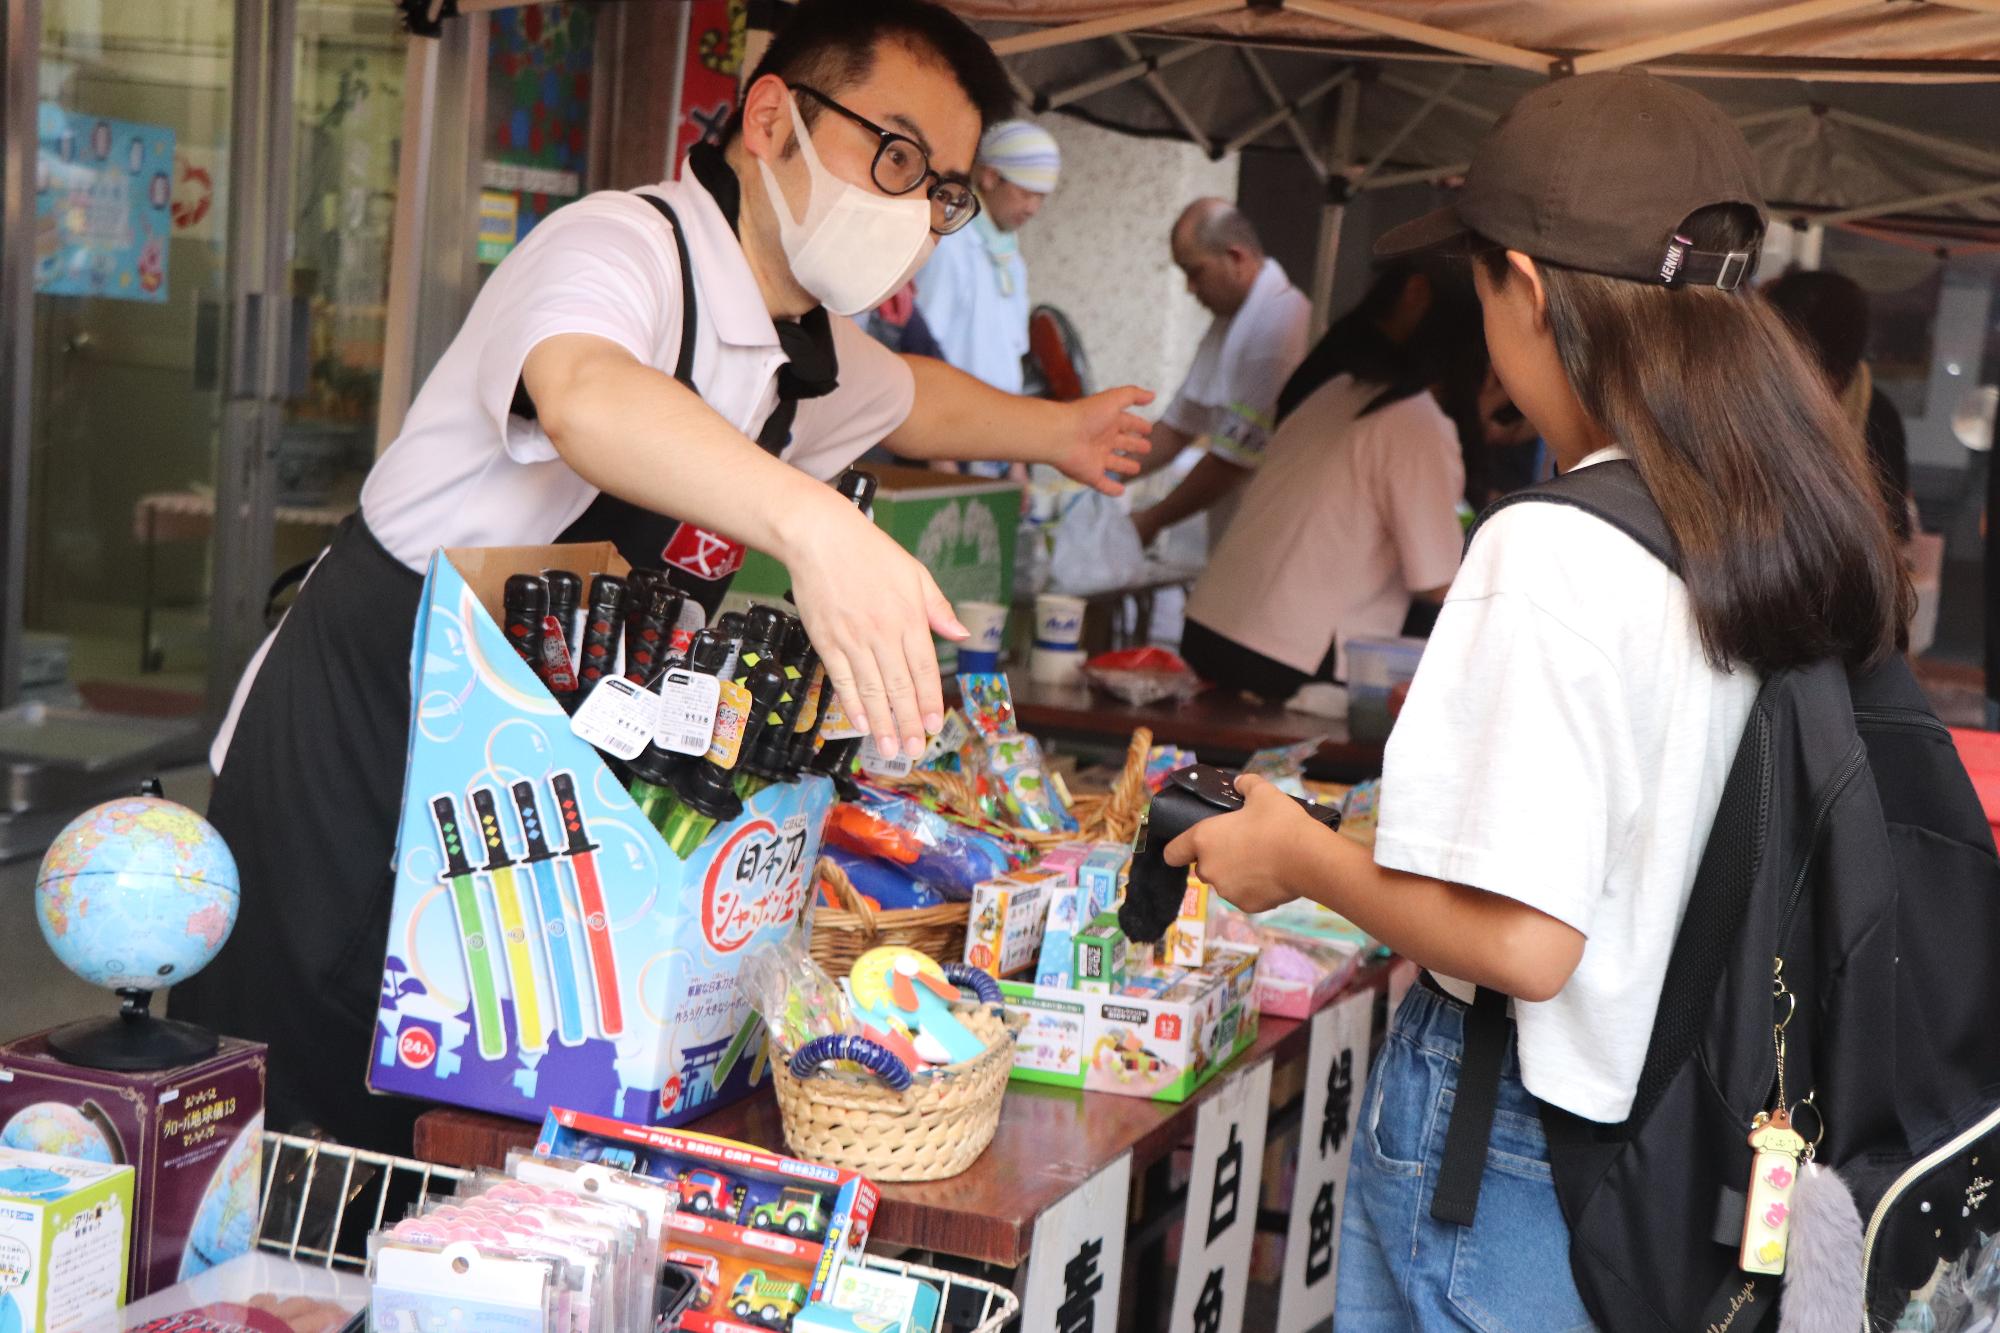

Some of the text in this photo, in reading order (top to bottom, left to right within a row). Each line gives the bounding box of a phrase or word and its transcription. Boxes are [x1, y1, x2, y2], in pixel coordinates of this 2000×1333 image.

[736, 828, 807, 887] 日本刀
[649, 1134, 685, 1150] PULL
